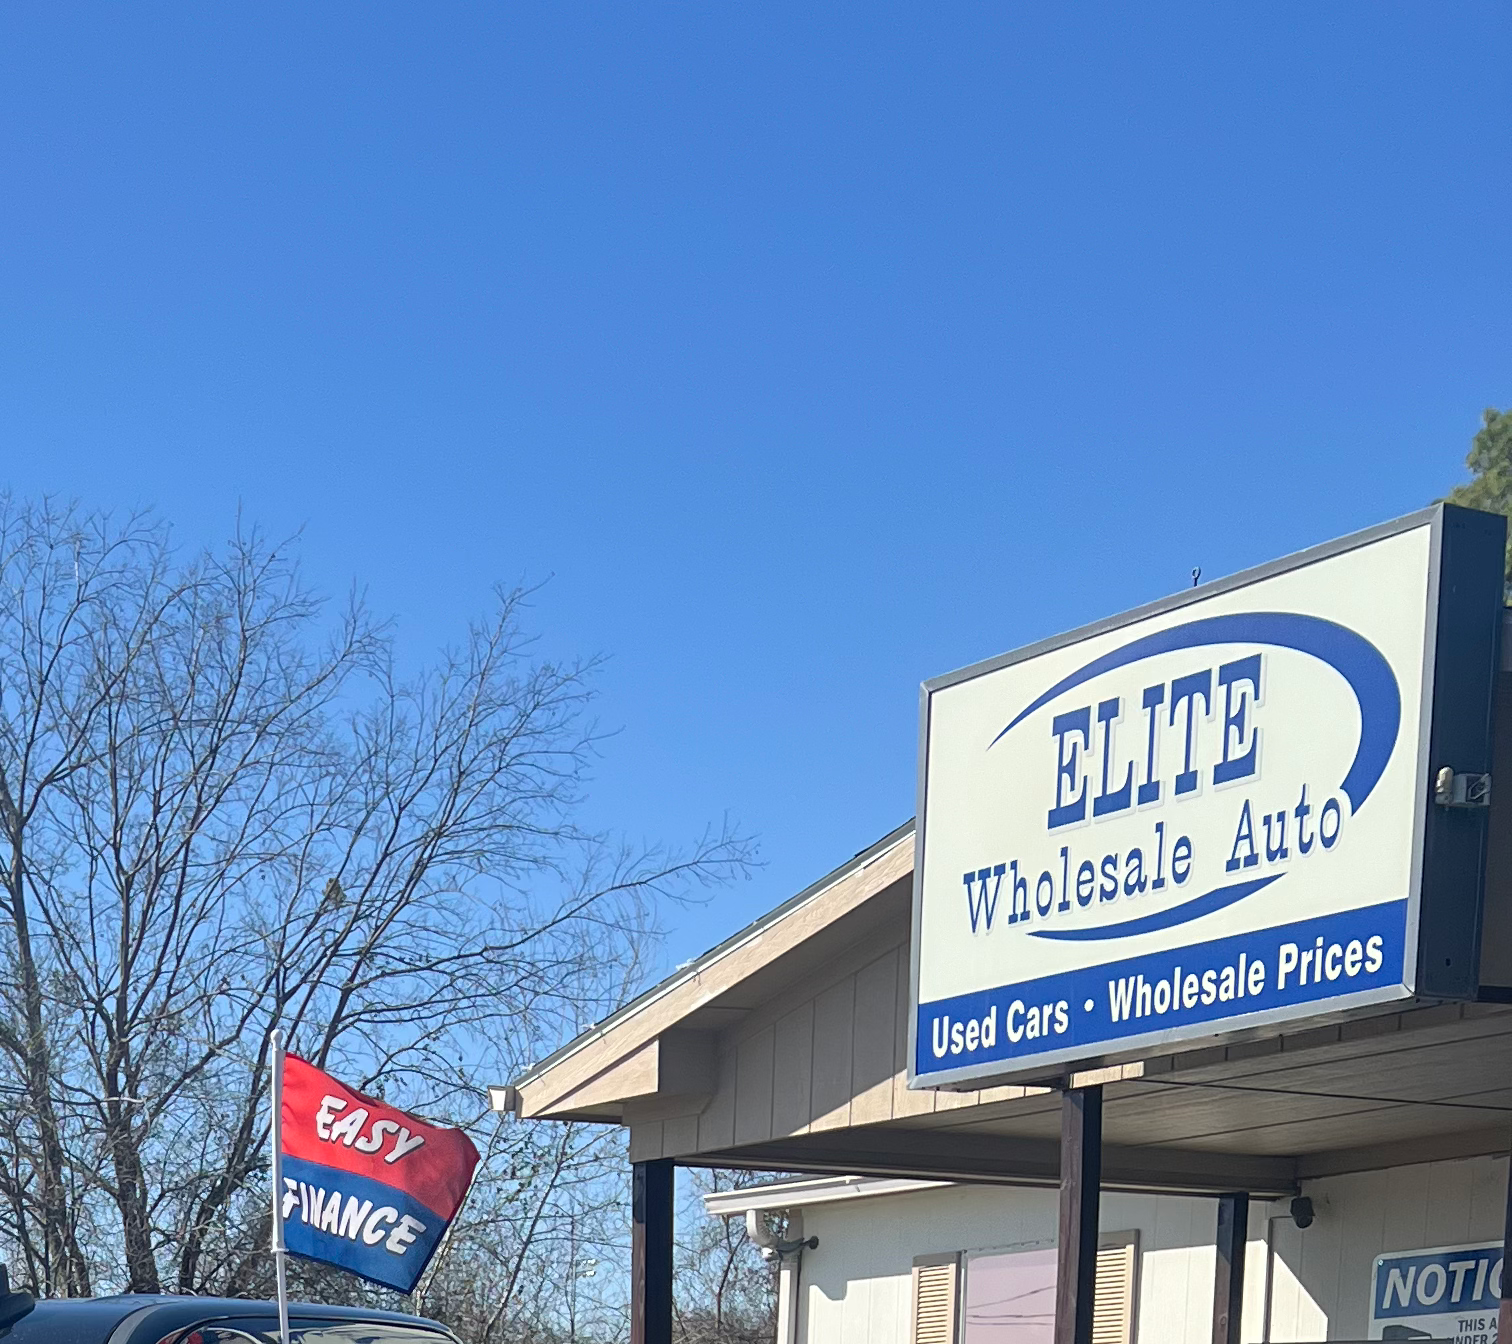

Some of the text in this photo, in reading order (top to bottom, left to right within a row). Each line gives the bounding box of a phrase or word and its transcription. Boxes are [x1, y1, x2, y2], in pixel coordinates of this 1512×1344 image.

[1048, 653, 1265, 830] ELITE
[963, 783, 1344, 935] Wholesale Auto
[932, 934, 1384, 1060] Used Cars Wholesale Prices
[315, 1093, 426, 1165] EASY
[282, 1176, 427, 1256] FINANCE
[1382, 1257, 1504, 1310] NOTIC
[1457, 1318, 1486, 1333] THIS
